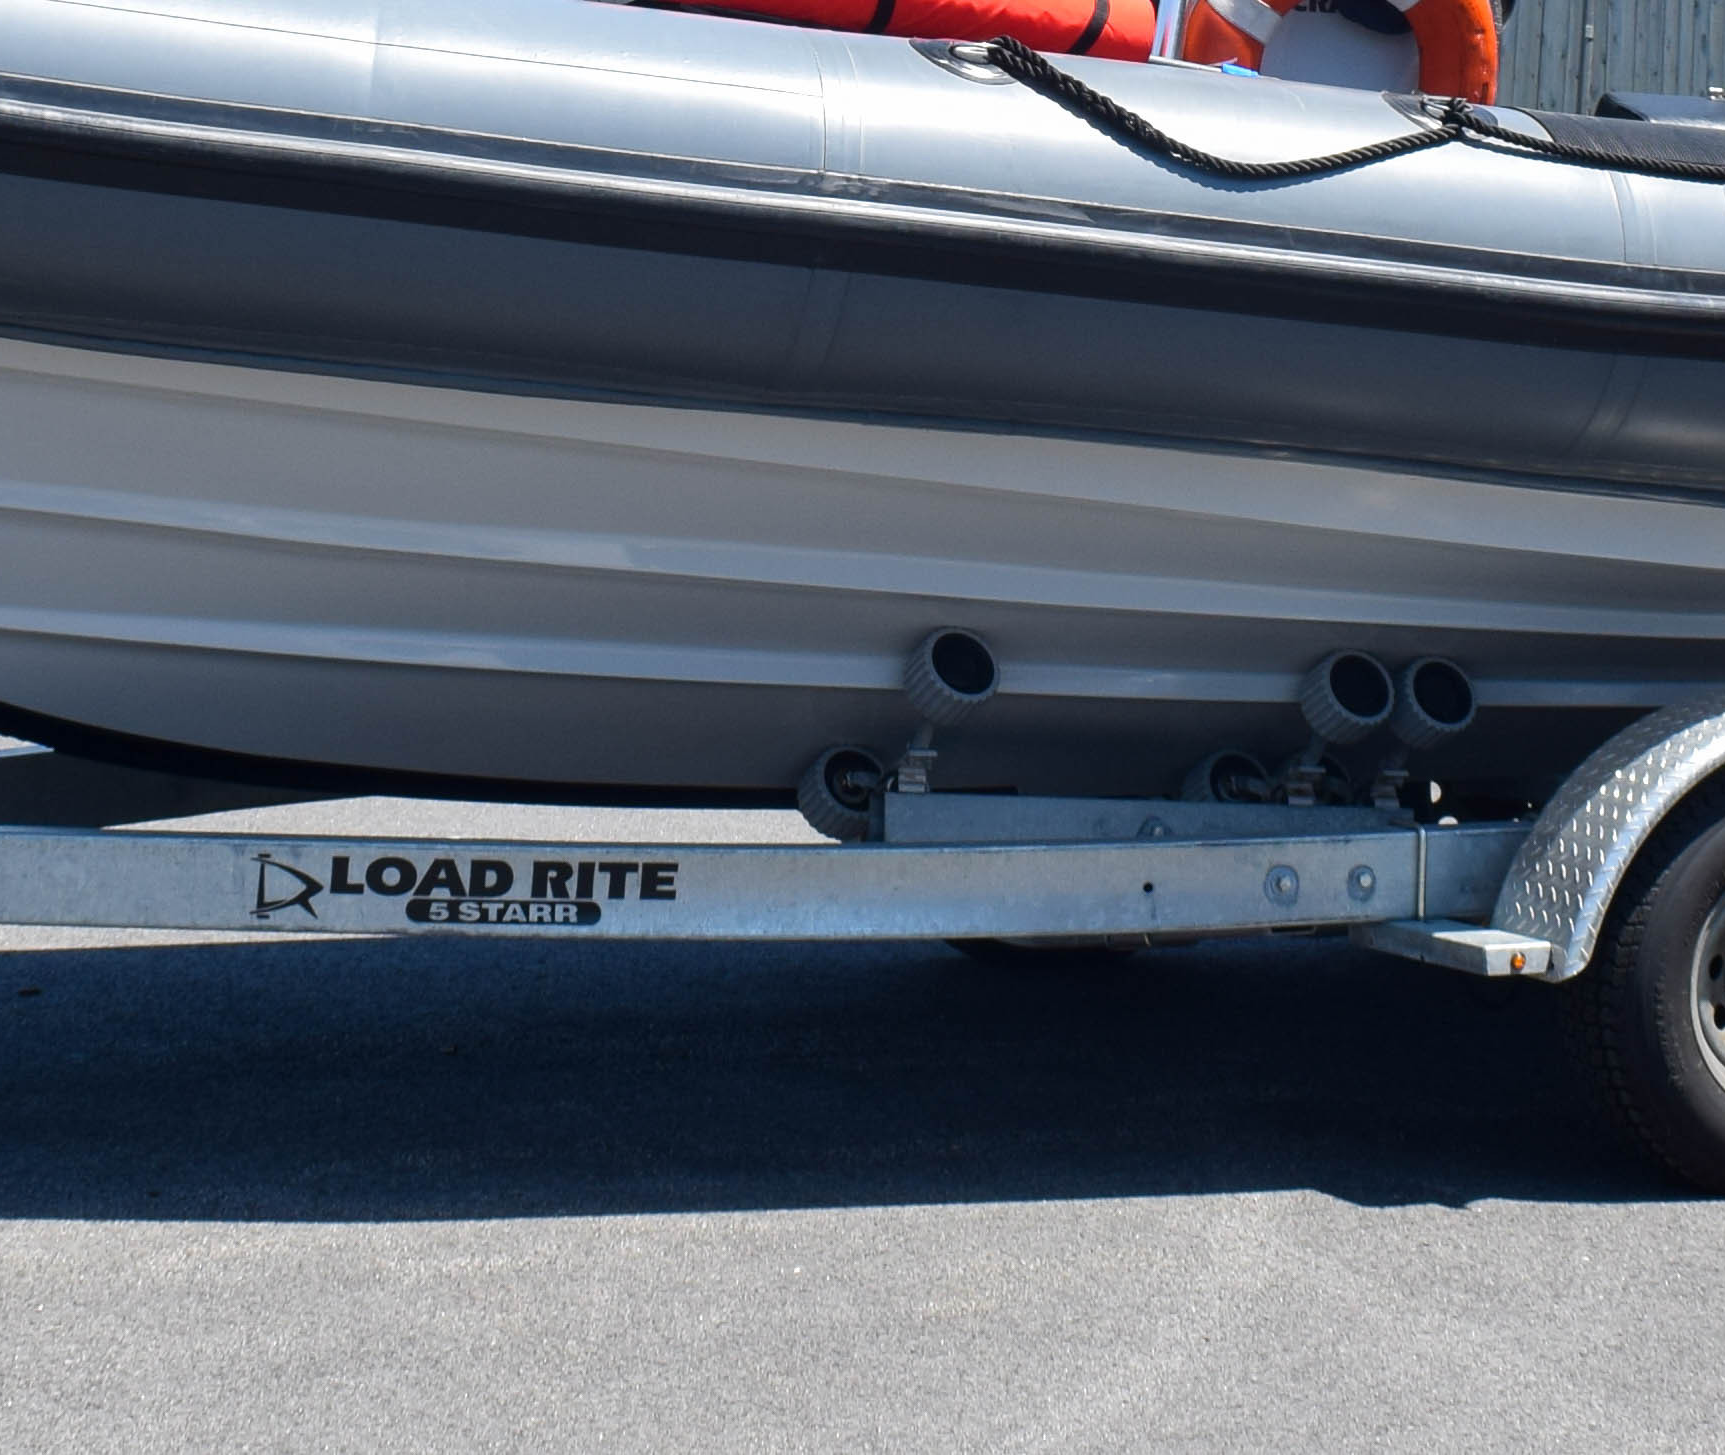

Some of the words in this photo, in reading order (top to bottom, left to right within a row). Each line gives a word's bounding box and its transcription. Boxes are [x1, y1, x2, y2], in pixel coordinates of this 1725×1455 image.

[329, 856, 515, 898] LOAD
[530, 860, 679, 901] RITE
[429, 902, 449, 921] 5
[458, 903, 578, 923] STARR
